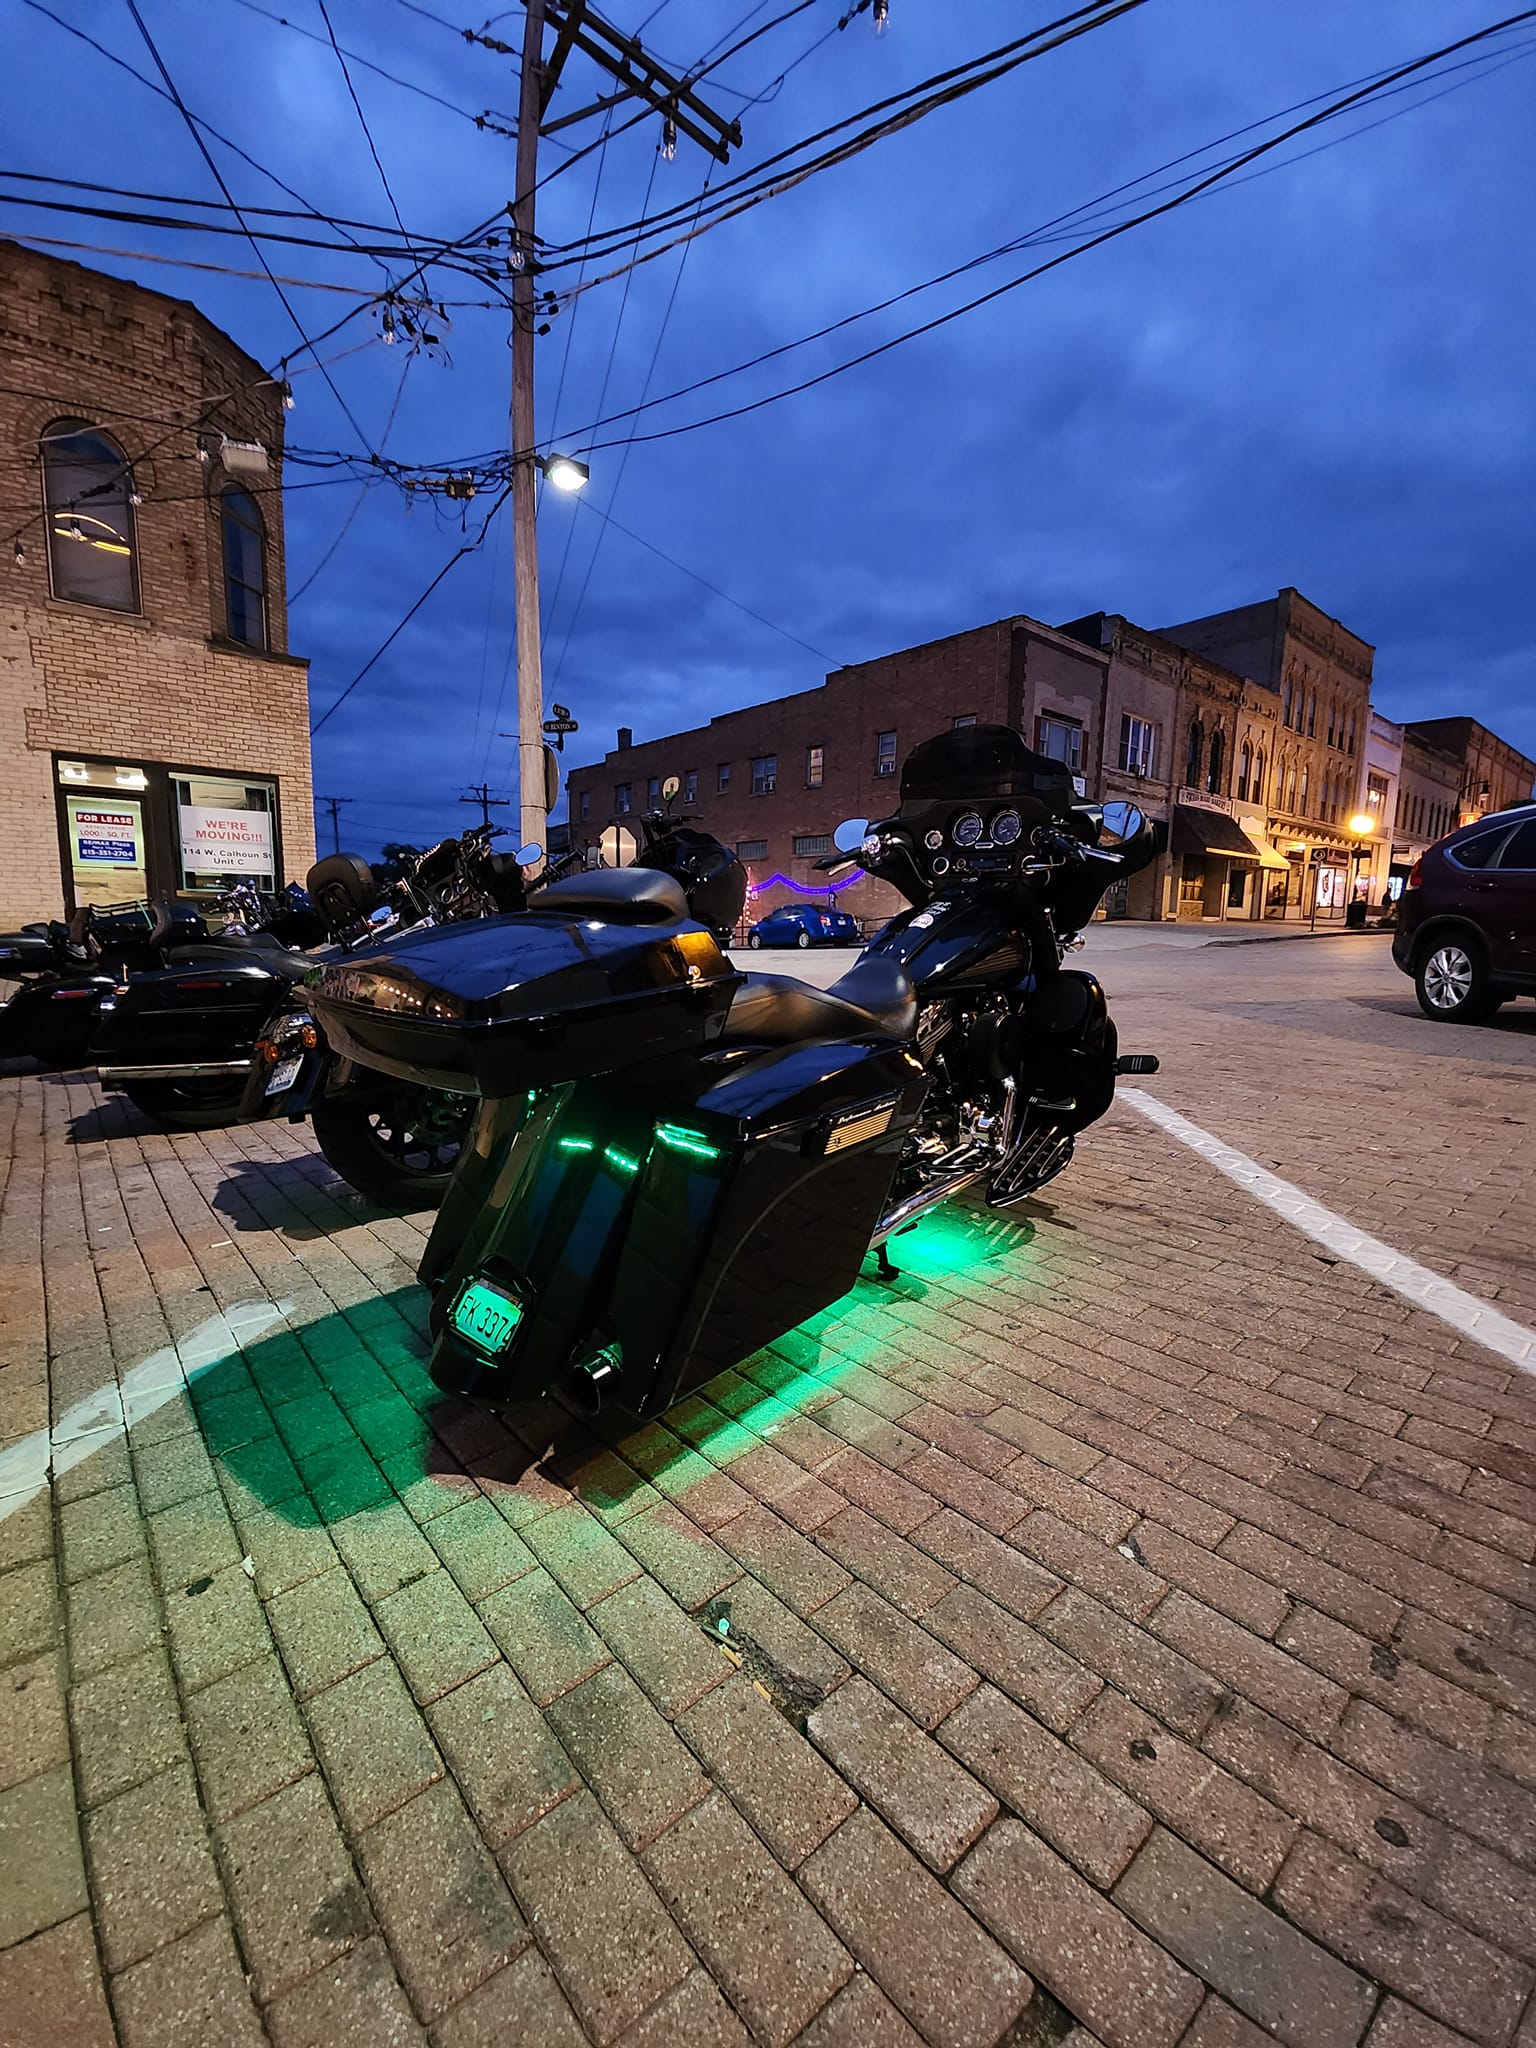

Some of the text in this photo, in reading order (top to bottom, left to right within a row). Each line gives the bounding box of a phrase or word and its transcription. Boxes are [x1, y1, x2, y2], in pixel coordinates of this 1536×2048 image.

[77, 813, 133, 825] FOR LEASE
[205, 819, 248, 831] WE'RE
[195, 830, 263, 842] MOVING!!!
[204, 848, 216, 856] W.
[219, 850, 260, 858] Calhoun
[237, 858, 245, 866] C
[458, 1295, 482, 1327] FK
